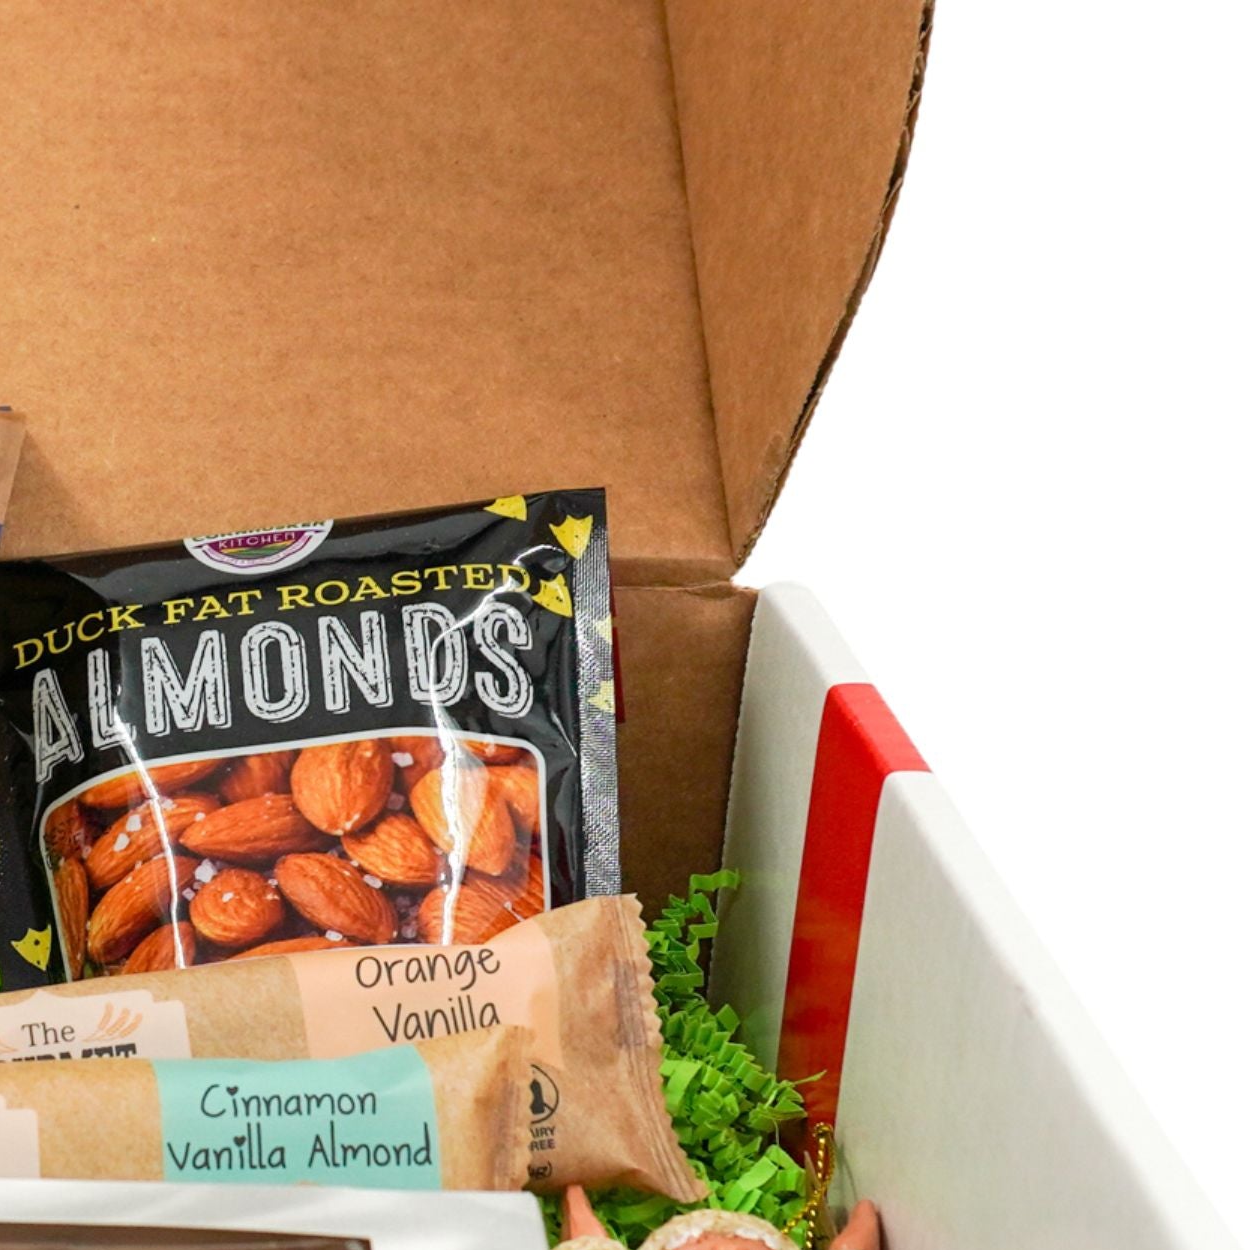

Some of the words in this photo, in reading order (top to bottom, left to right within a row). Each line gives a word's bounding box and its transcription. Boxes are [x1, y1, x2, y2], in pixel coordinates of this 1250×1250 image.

[218, 532, 295, 549] KITCHEN
[12, 606, 143, 670] DUCK
[163, 589, 264, 626] FAT
[276, 563, 532, 611] ROASTED
[31, 601, 534, 784] ALMONDS
[355, 948, 500, 991] Orange
[21, 1022, 76, 1047] The
[372, 994, 500, 1043] Vanilla
[200, 1083, 378, 1119] Cinnamon
[167, 1121, 286, 1172] Vanilla
[307, 1120, 433, 1170] Almond
[528, 1139, 556, 1151] REE
